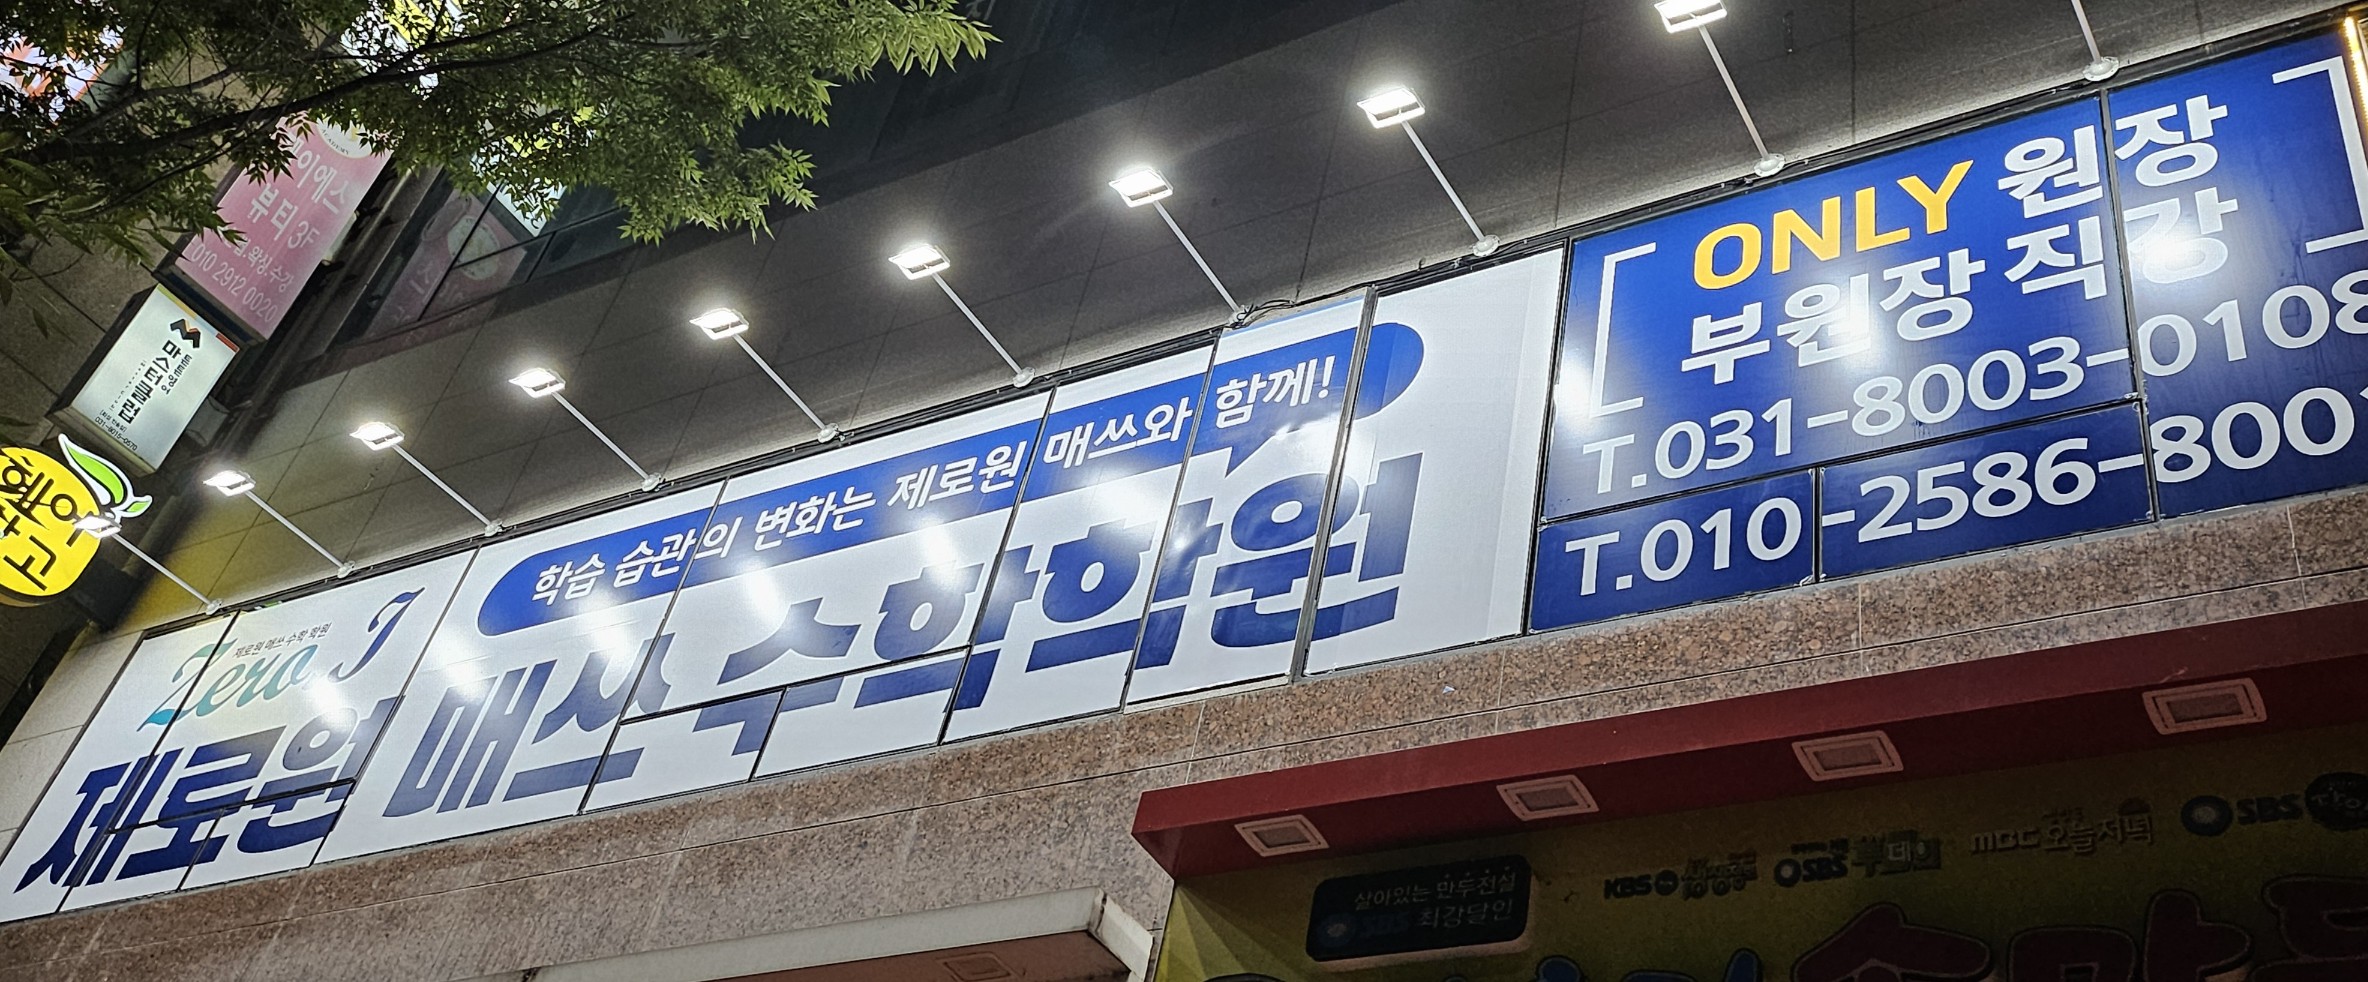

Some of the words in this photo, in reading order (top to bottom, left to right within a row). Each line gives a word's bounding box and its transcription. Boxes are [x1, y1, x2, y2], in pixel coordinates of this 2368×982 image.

[247, 183, 299, 241] 뷰티
[288, 221, 321, 249] 3F
[1693, 159, 1974, 291] ONLY
[1997, 95, 2228, 219] 원장
[192, 243, 217, 275] 010
[212, 262, 247, 295] 2912
[243, 287, 279, 322] 0020
[1681, 248, 1986, 386] 부원장
[2004, 186, 2239, 301] 직강
[118, 340, 182, 425] 마스터클럽
[531, 553, 605, 606] 학습
[615, 516, 743, 590] 습관의
[753, 485, 877, 552] 변화는
[886, 440, 1028, 511] 제로원
[1042, 396, 1194, 470] 매쓰와
[1214, 354, 1336, 430] 함께!
[1564, 387, 2368, 597] T.010-2586-800
[0, 510, 57, 592] 고
[136, 637, 319, 732] Zero
[13, 695, 405, 893] 제로원
[382, 632, 677, 818] 매쓰
[1354, 883, 1431, 911] 살아있는
